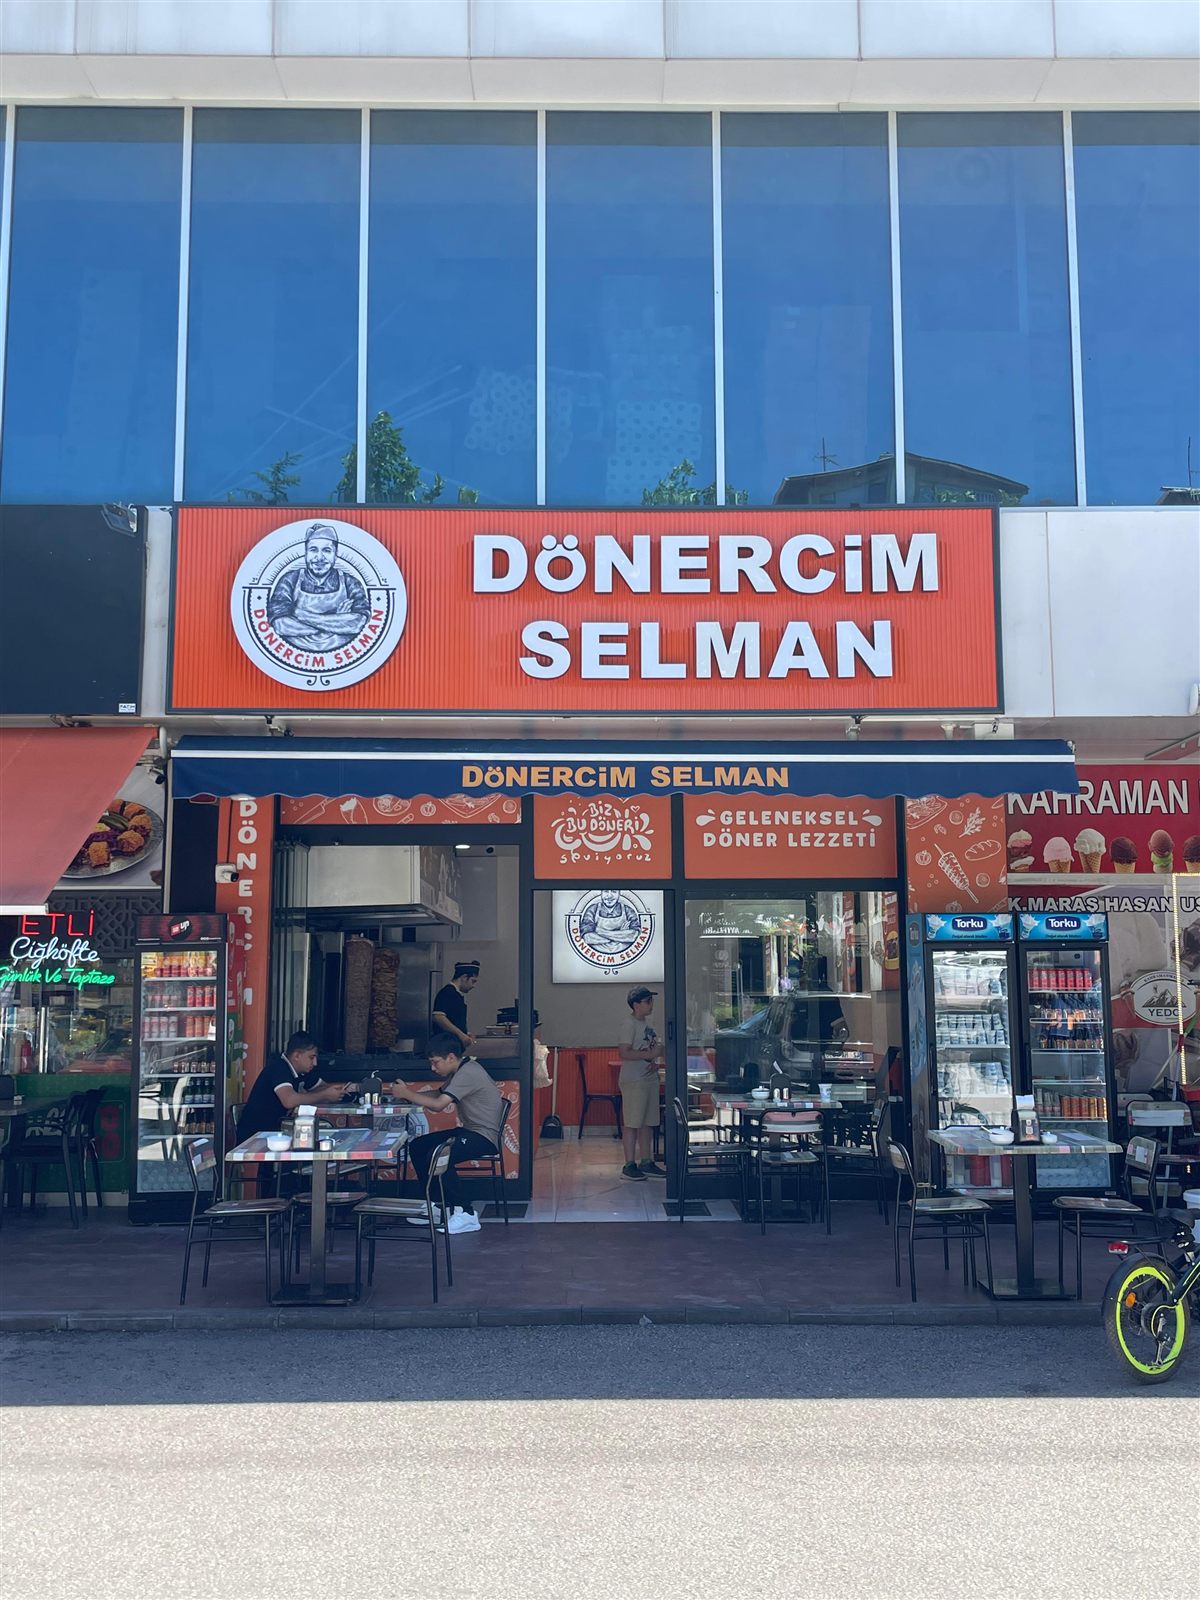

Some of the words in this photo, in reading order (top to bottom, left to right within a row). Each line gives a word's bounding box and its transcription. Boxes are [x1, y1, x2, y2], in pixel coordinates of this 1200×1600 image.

[334, 609, 384, 664] SELMAN
[519, 620, 893, 679] SELMAN
[650, 766, 789, 788] SELMAN
[1007, 780, 1189, 814] KAHRAMAN
[566, 817, 586, 832] BU
[590, 817, 640, 833] DÖNERİ
[719, 811, 858, 826] GELENEKSEL
[703, 828, 778, 847] DÖNER
[788, 828, 876, 847] LEZZETİ
[559, 852, 652, 865] seviyoruz
[1105, 897, 1173, 913] HASAN
[22, 909, 95, 936] ETLİ
[954, 918, 984, 928] Torku
[1048, 918, 1078, 928] Torku
[10, 936, 100, 969] Çiğköfte
[620, 927, 649, 961] SELMAN
[0, 966, 42, 989] Günlük
[45, 967, 62, 984] Ve
[65, 968, 116, 991] Taptaze
